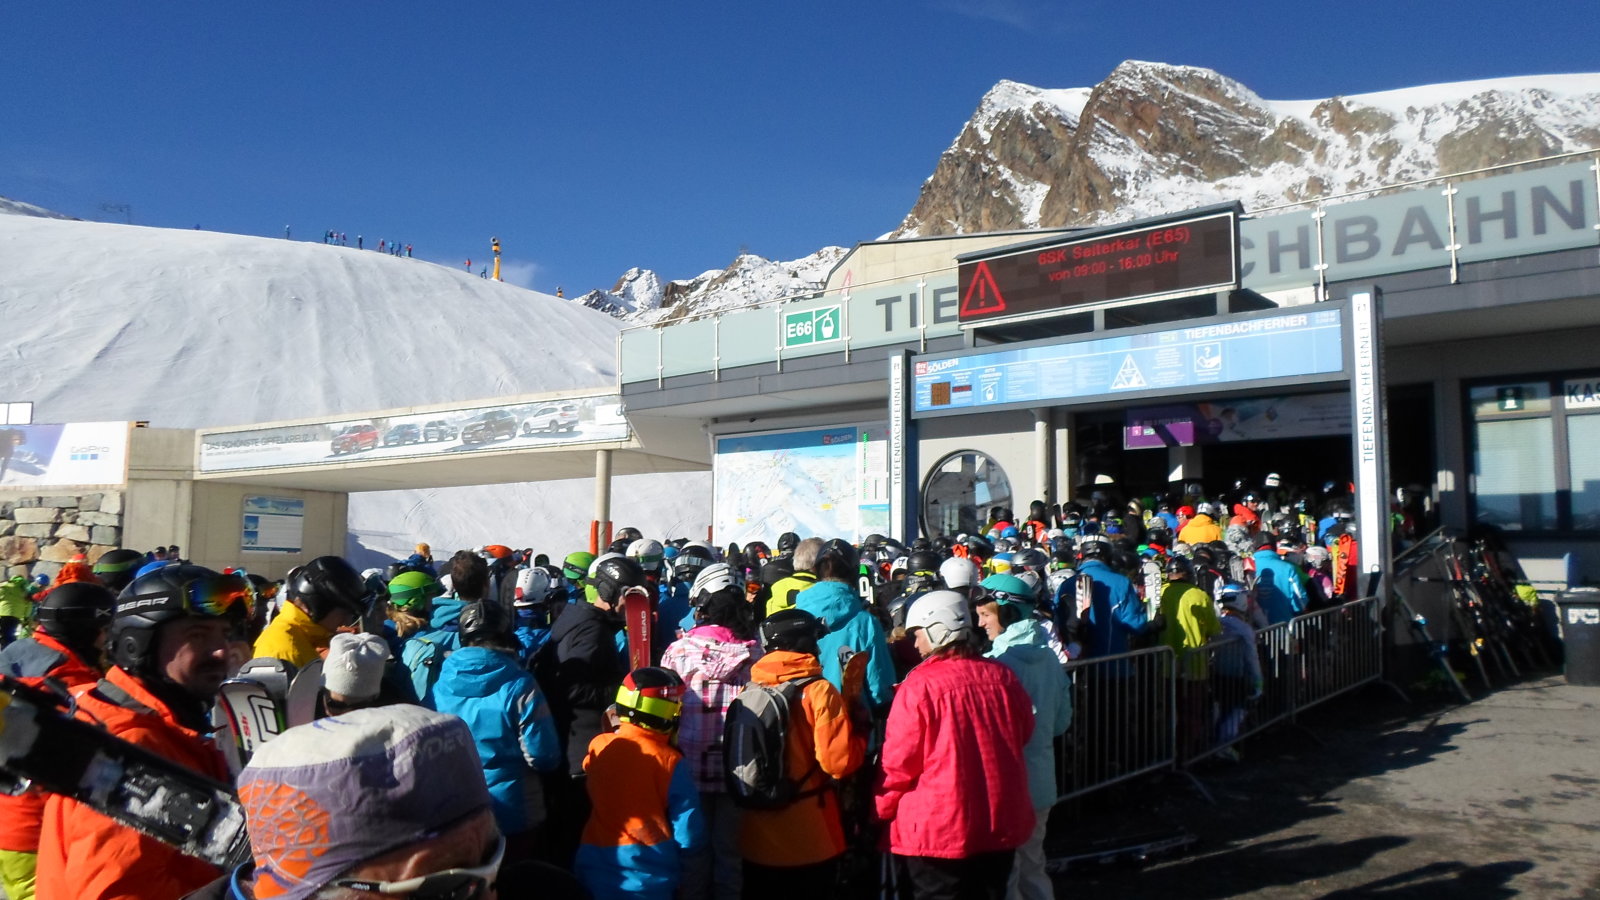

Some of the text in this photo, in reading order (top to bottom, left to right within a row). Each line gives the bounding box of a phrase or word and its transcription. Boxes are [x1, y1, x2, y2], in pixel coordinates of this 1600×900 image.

[1145, 226, 1191, 249] (E65)
[1048, 269, 1071, 282] von
[1074, 261, 1106, 277] 09:00
[1155, 249, 1179, 264] Uhr
[787, 320, 813, 339] E66
[1184, 315, 1308, 341] TIEFENBACHFERNER
[928, 358, 959, 374] SÖLDEN
[1359, 321, 1375, 465] TIEFENBACHFERNER
[893, 377, 902, 485] TIEFENBACHFERNER
